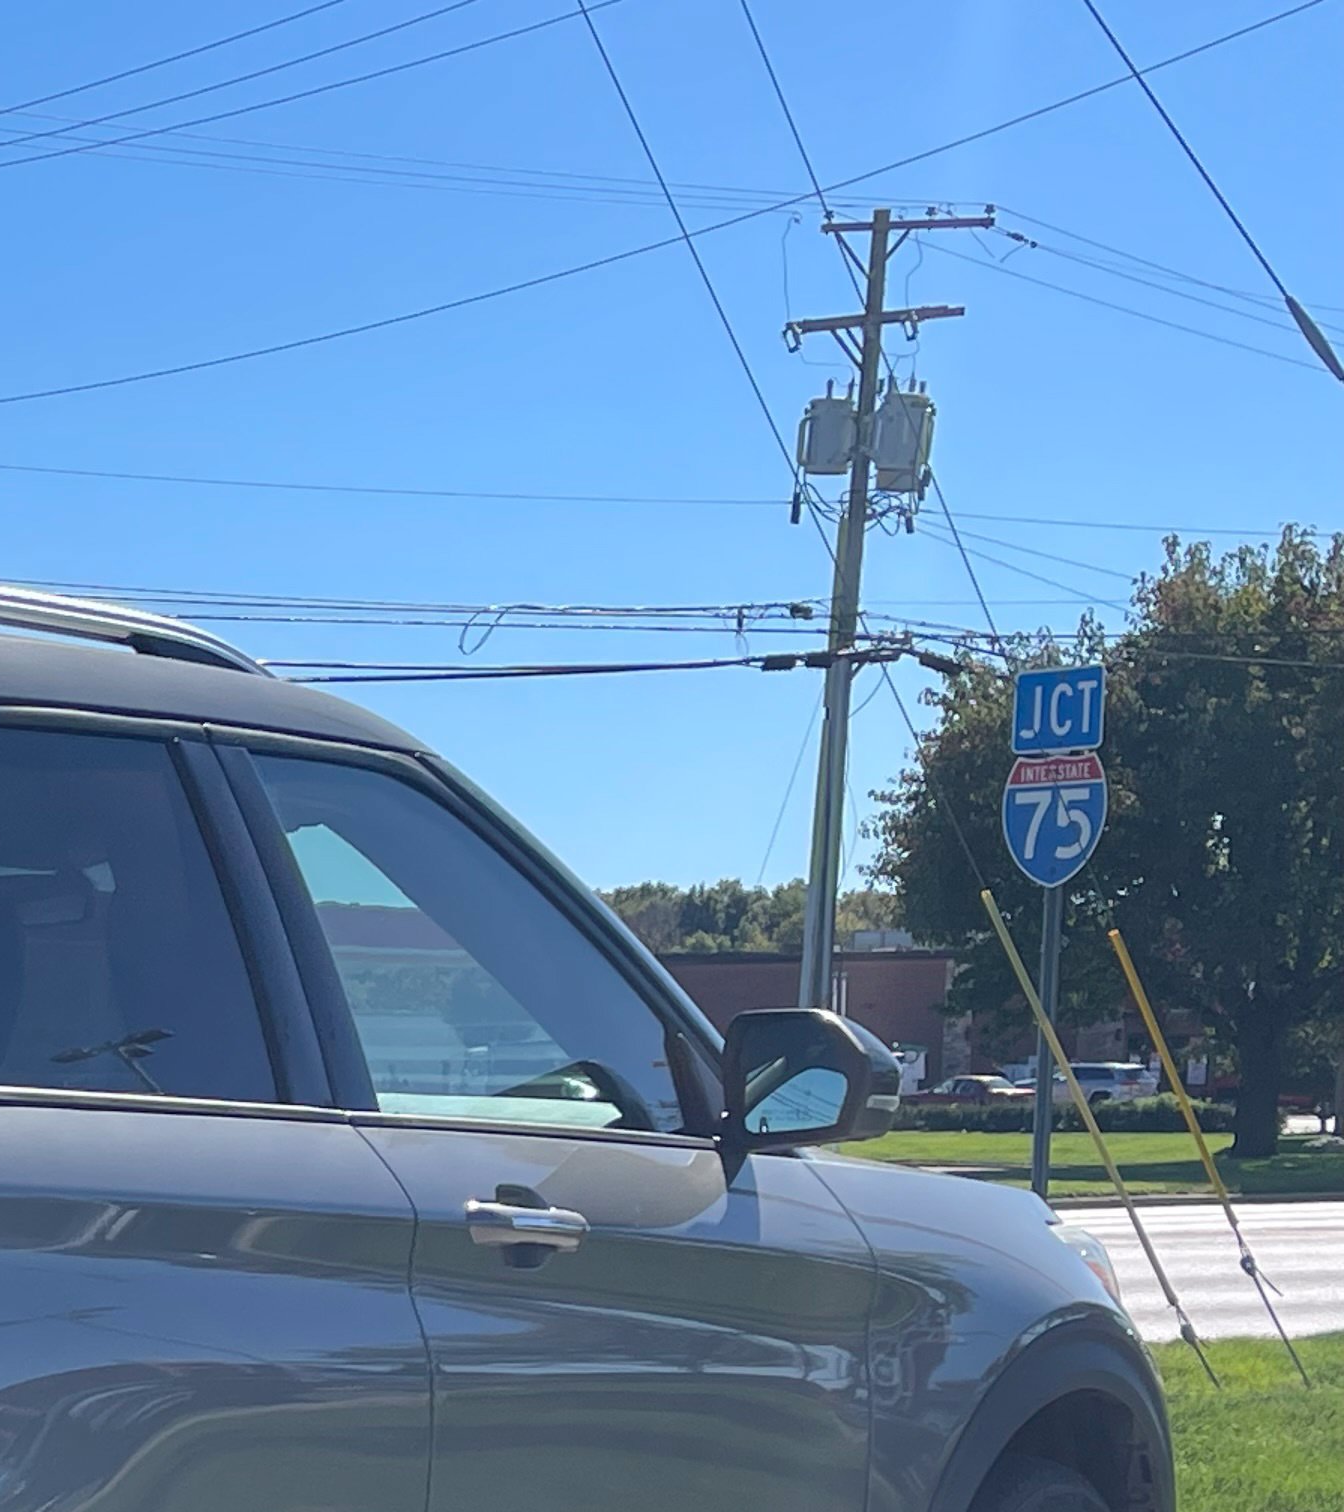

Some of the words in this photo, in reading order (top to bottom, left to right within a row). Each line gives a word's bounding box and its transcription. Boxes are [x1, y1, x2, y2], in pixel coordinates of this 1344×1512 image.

[1018, 679, 1098, 740] JCT
[1020, 761, 1092, 783] INTERSTATE
[1014, 787, 1092, 860] 75
